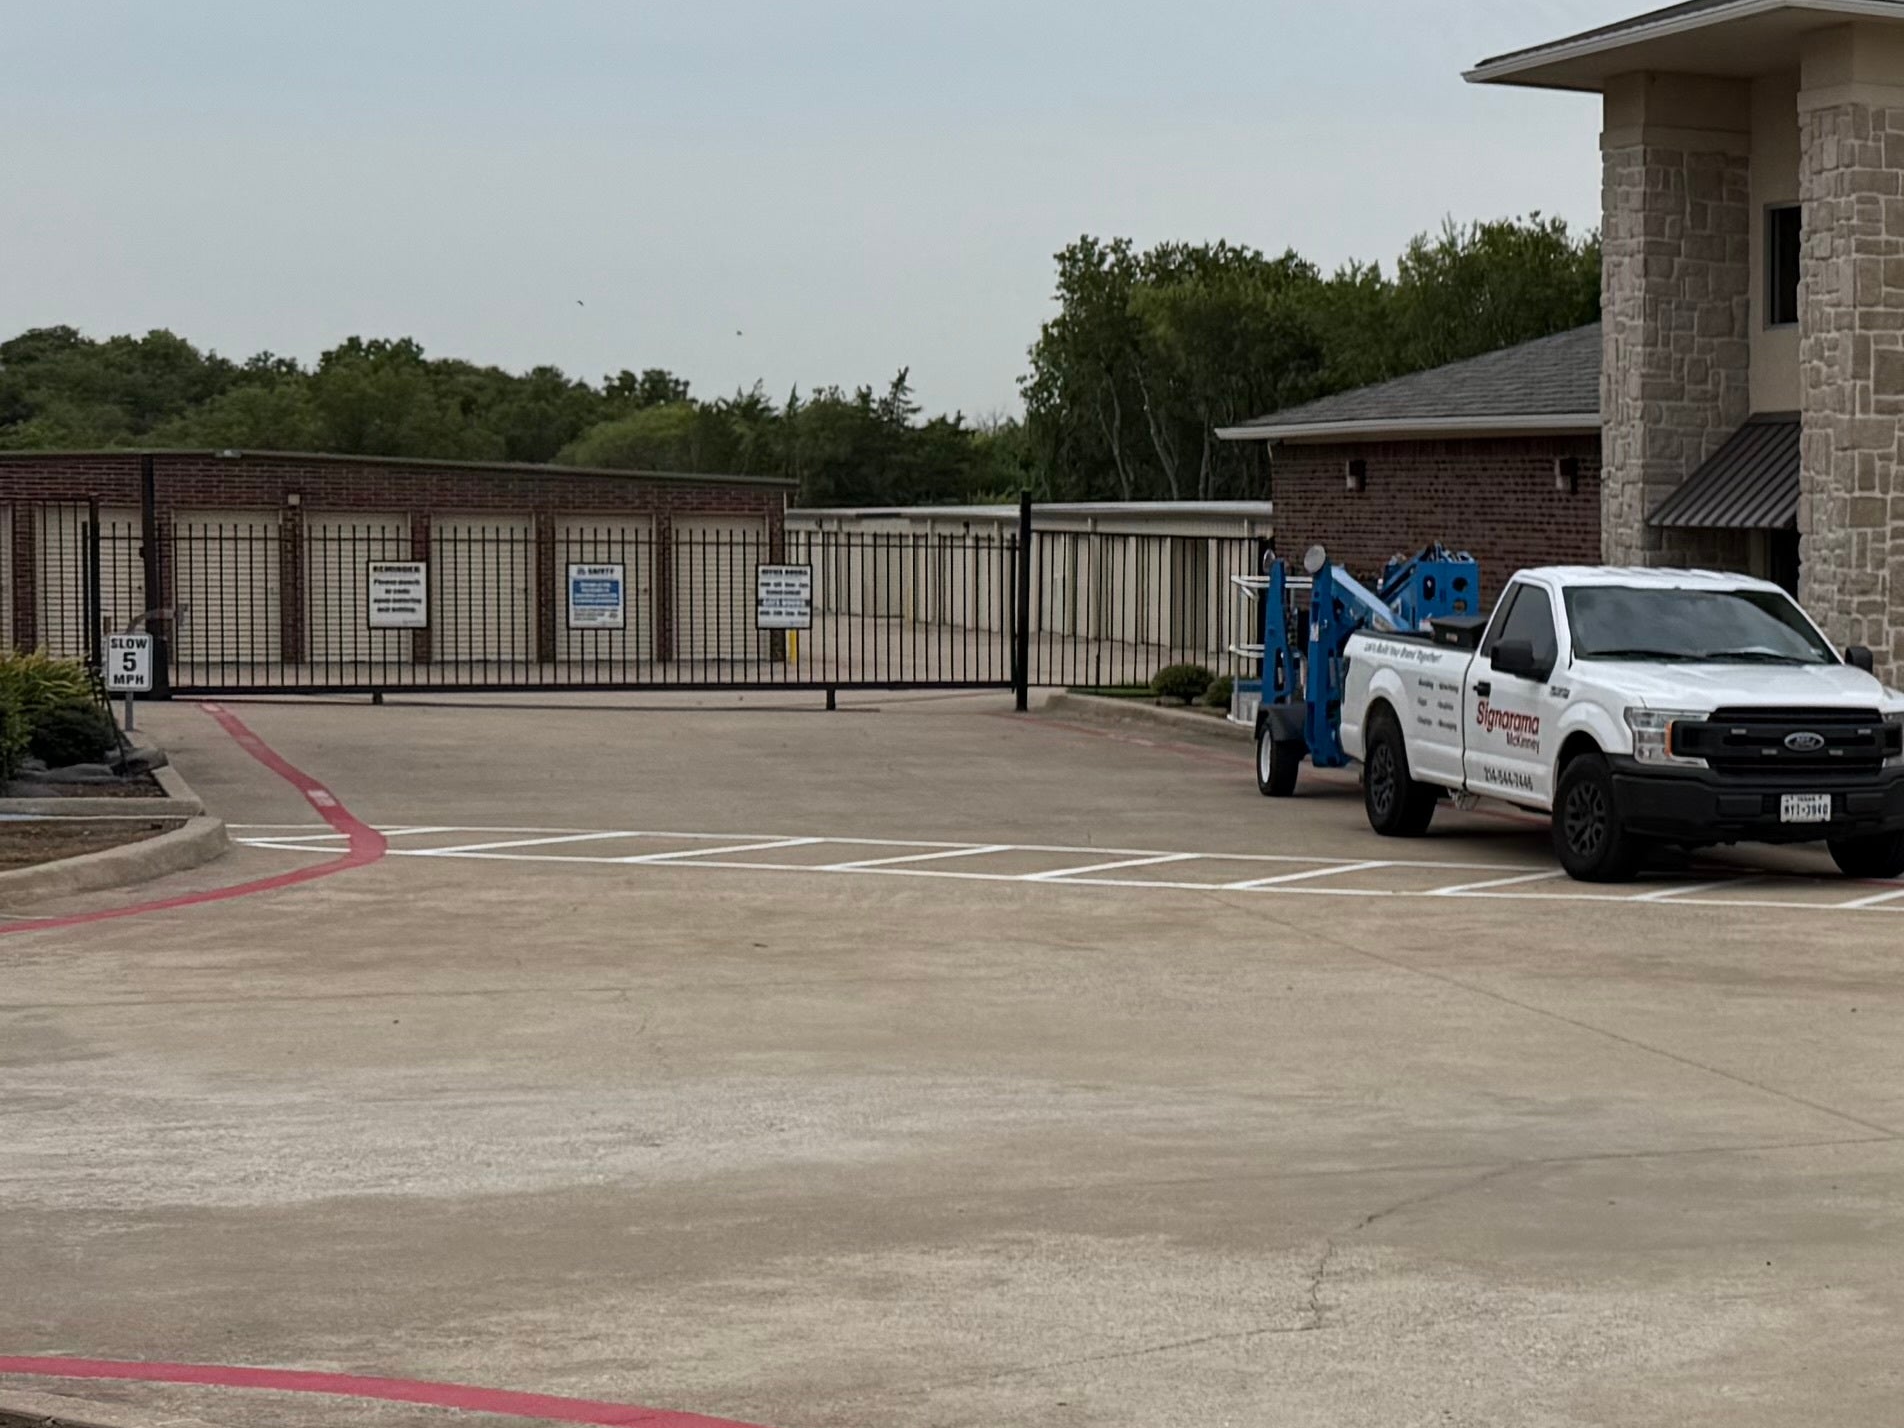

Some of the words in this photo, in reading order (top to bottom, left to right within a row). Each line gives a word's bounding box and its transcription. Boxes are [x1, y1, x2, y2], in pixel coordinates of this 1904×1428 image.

[110, 638, 147, 649] SLOW
[122, 652, 137, 672] 5
[113, 674, 144, 685] MPH
[1476, 701, 1540, 735] Signarama
[1506, 731, 1540, 754] McKinney
